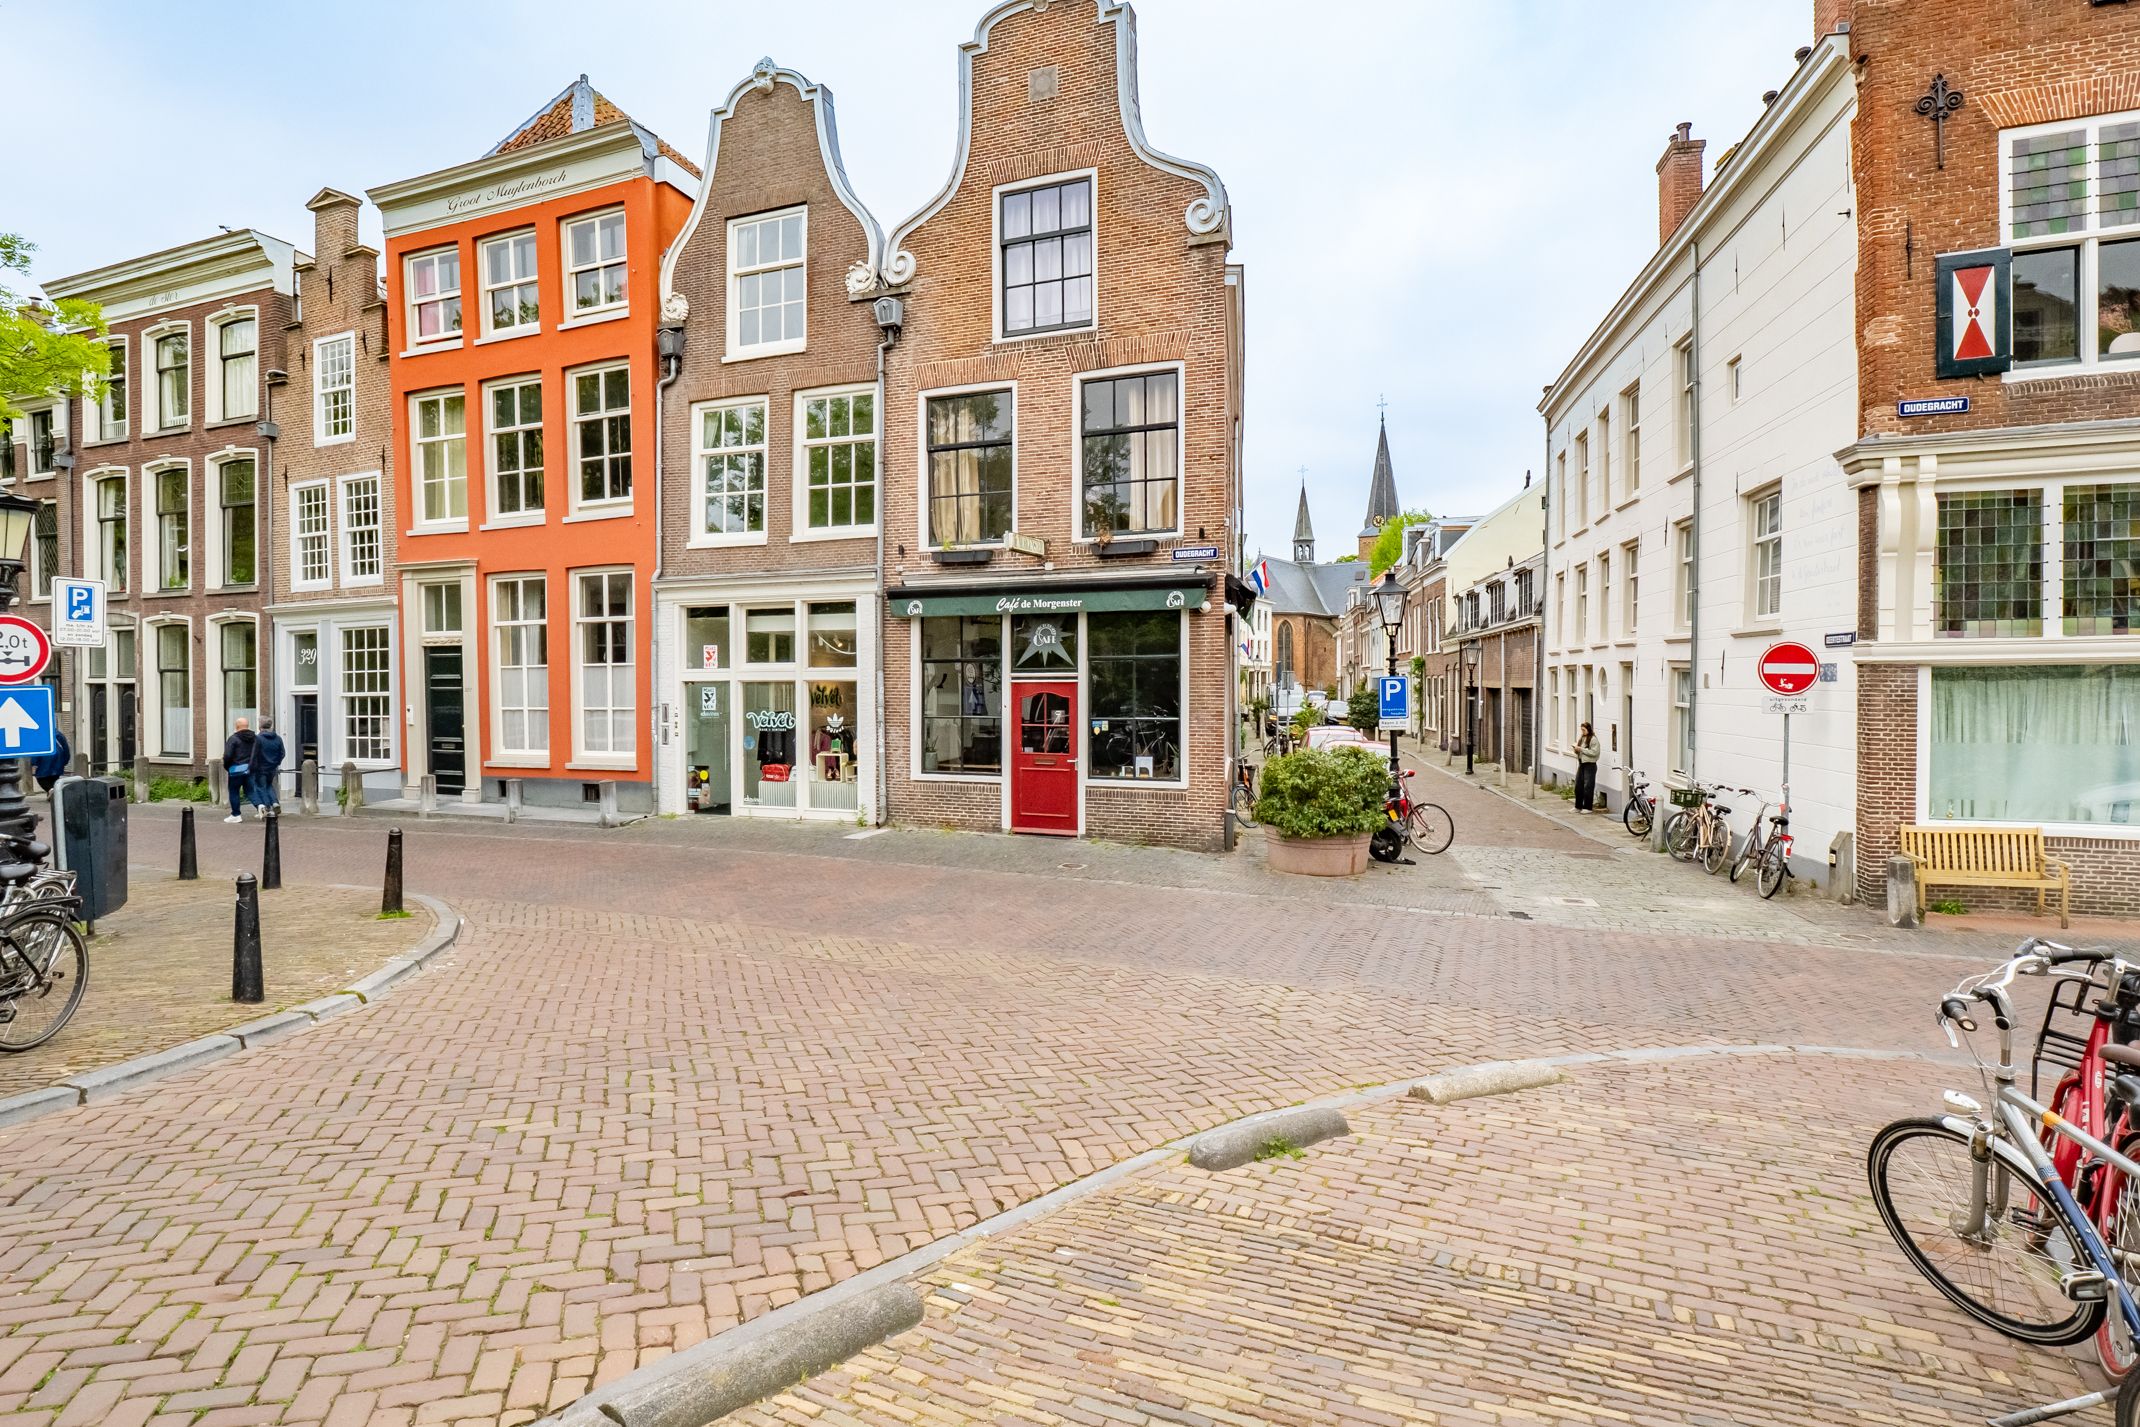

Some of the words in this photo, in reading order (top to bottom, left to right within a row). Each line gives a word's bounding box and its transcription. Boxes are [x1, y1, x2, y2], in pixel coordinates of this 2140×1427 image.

[447, 194, 480, 214] Groot
[1903, 400, 1964, 413] OUDEGRACHT
[1175, 549, 1215, 559] OUDEGRACHT
[72, 588, 89, 607] P
[996, 597, 1020, 612] Café
[1020, 600, 1032, 609] de
[1033, 599, 1083, 610] Morgenster
[298, 648, 317, 665] 329
[1385, 680, 1402, 701] P
[746, 710, 796, 729] Velvet
